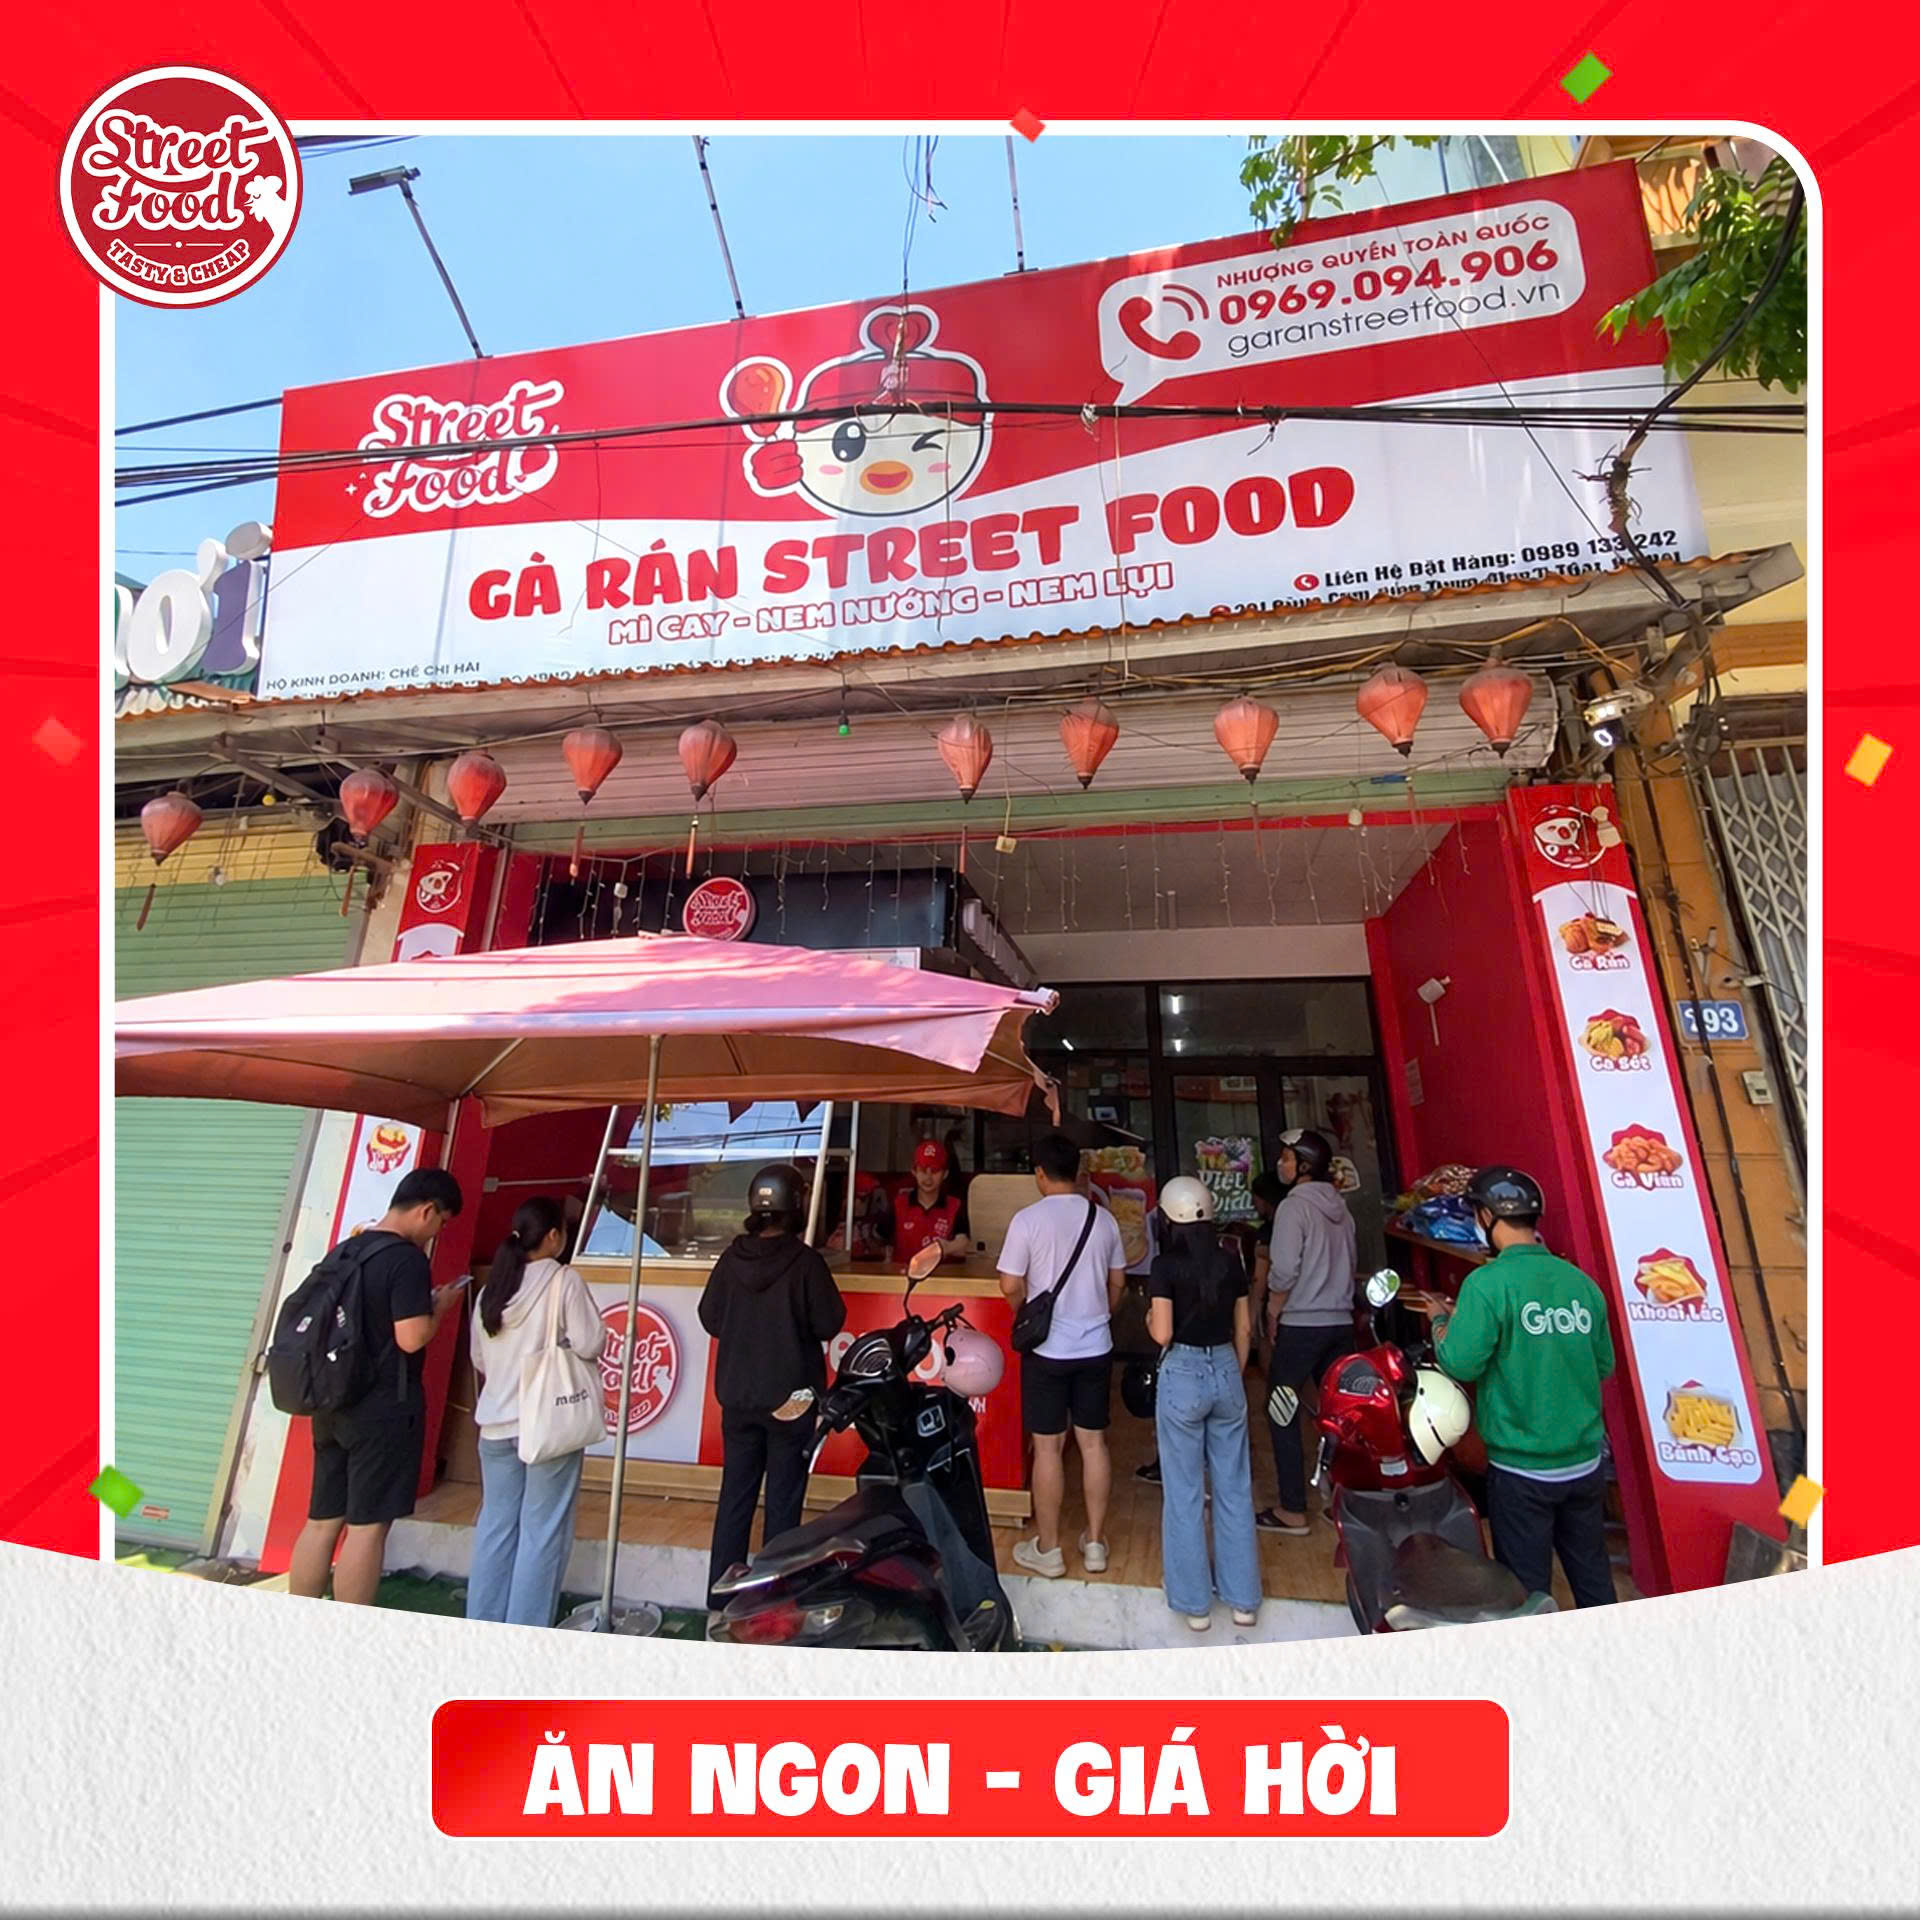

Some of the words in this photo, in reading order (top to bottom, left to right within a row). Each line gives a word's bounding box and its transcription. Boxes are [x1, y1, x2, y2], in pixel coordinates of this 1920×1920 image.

[1404, 230, 1467, 253] TOÀN
[1219, 239, 1558, 325] 0969.094.906
[1228, 283, 1560, 358] garanstreetfood.vn
[360, 381, 564, 454] Street
[364, 452, 515, 517] Food
[468, 551, 561, 620] GÀ
[586, 538, 738, 610] RÁN
[763, 505, 1079, 593] STREET
[1106, 466, 1355, 555] FOOD
[1521, 542, 1579, 563] 0989
[1587, 536, 1629, 554] 133
[1634, 529, 1678, 549] 242
[658, 610, 729, 639] CAY
[757, 601, 834, 633] NEM
[842, 583, 979, 625] NƯỚNG
[1009, 572, 1097, 608] NEM
[1103, 562, 1174, 599] LỤI
[291, 675, 324, 688] KINH
[1521, 1300, 1593, 1335] Grab
[1629, 1302, 1686, 1321] Khoai
